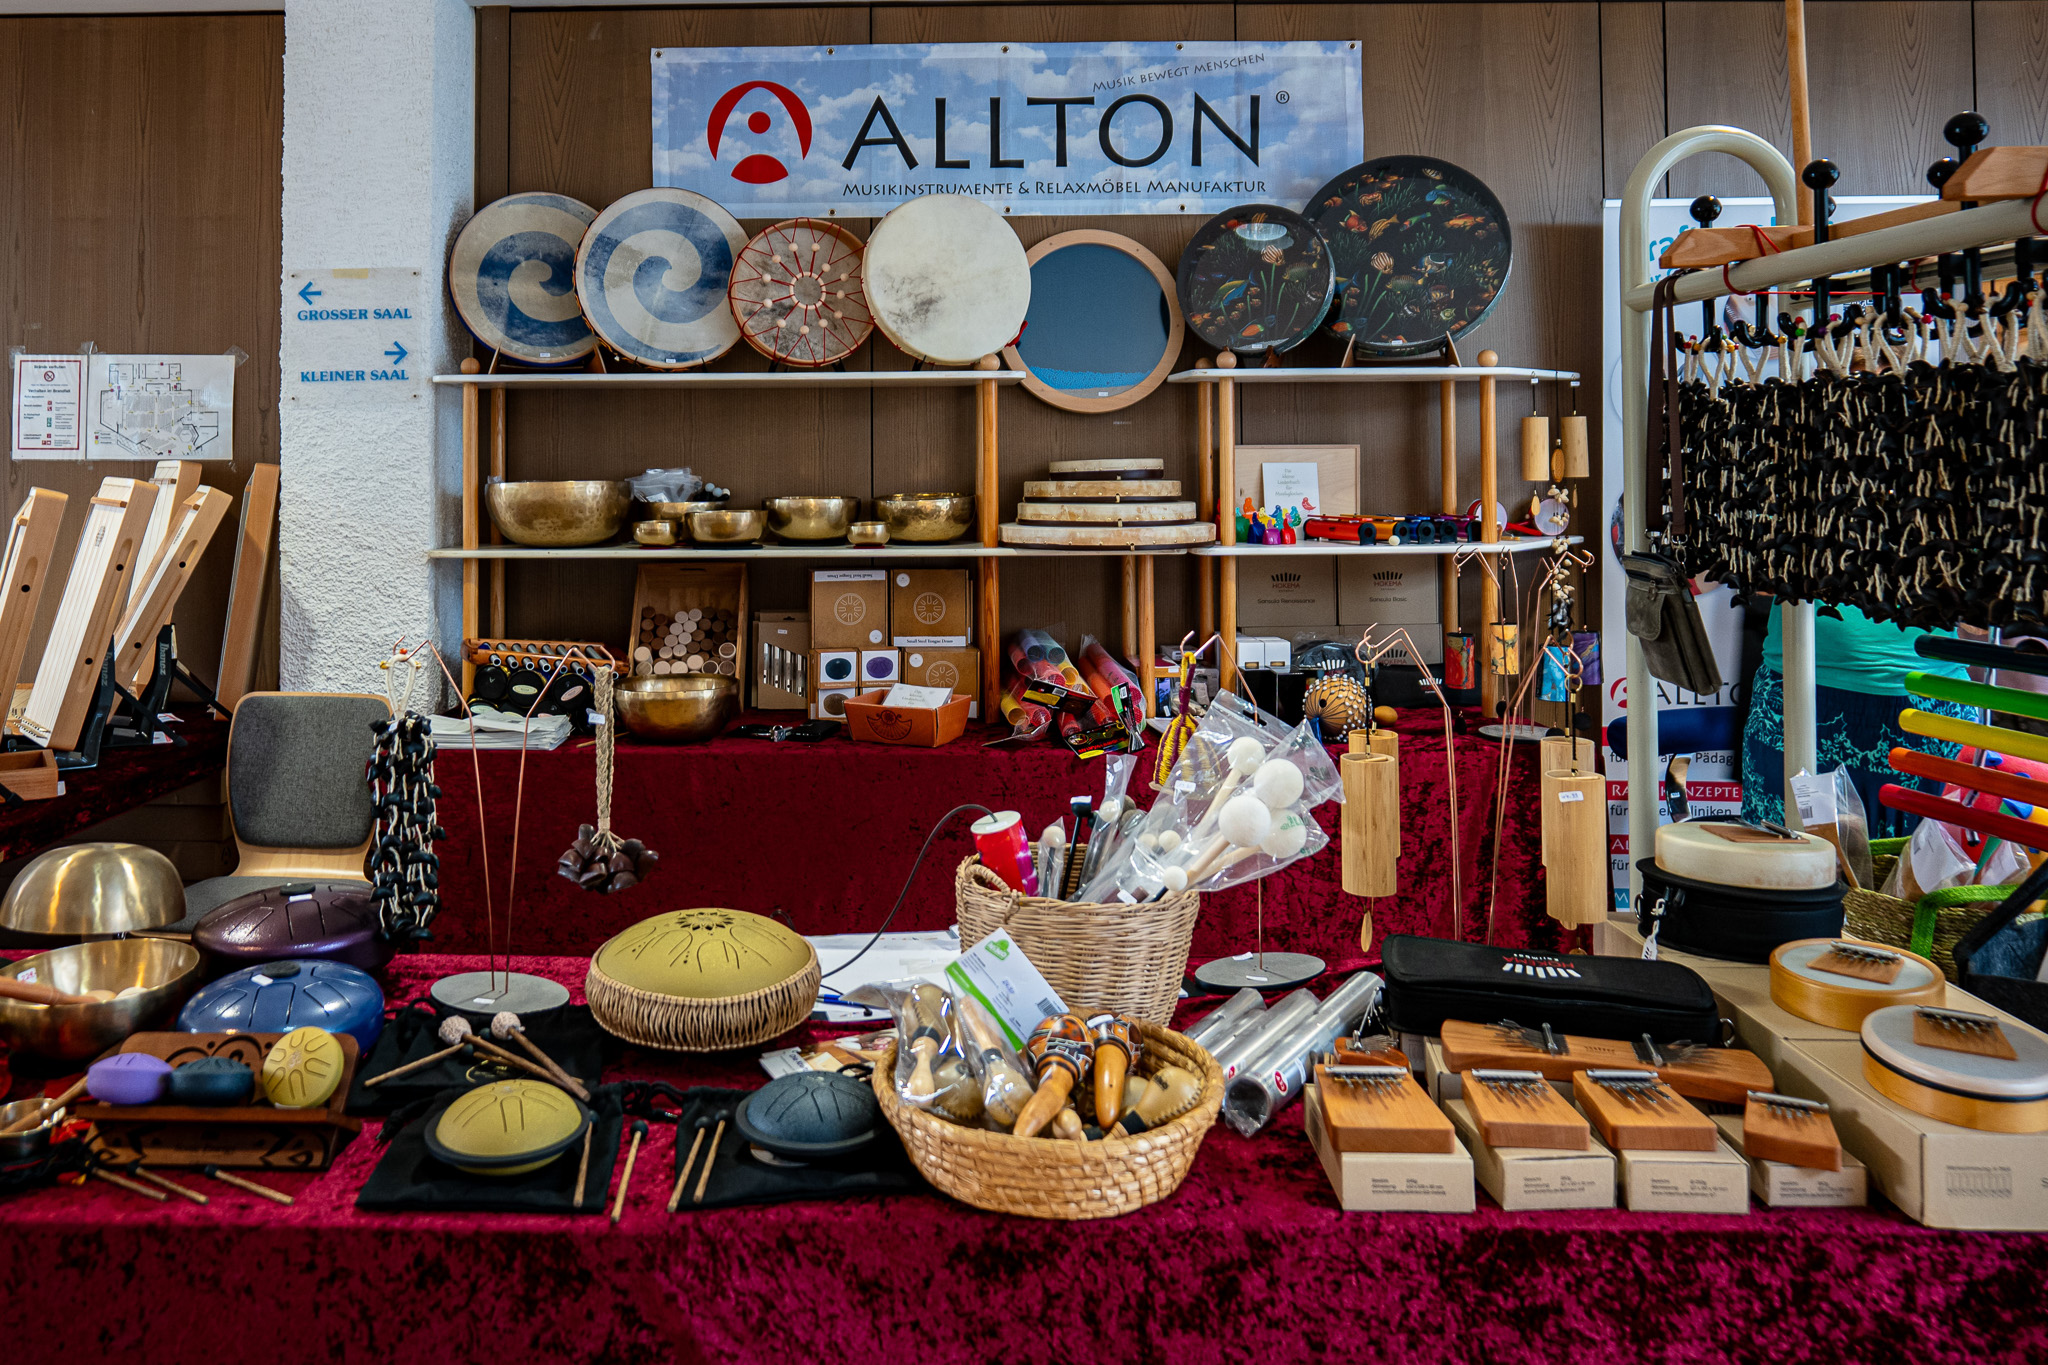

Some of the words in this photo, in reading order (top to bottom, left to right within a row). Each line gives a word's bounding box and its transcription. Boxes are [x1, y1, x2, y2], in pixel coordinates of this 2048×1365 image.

[1093, 76, 1136, 92] MUSIK
[1140, 66, 1190, 84] BEWEGT
[1193, 53, 1265, 74] MENSCHEN
[842, 91, 1260, 171] ALLTON
[843, 182, 1013, 196] MUSIKINSTRUMENTE
[1018, 181, 1030, 194] &
[1036, 179, 1141, 194] RELAXMÖBEL
[1147, 180, 1266, 193] MANUFAKTUR
[297, 309, 368, 320] GROSSER
[373, 308, 412, 319] SAAL
[301, 370, 366, 382] KLEINER
[370, 369, 409, 381] SAAL
[160, 642, 170, 676] Ibanez
[1695, 752, 1735, 766] Pädag
[1503, 956, 1574, 968] HOKEMA
